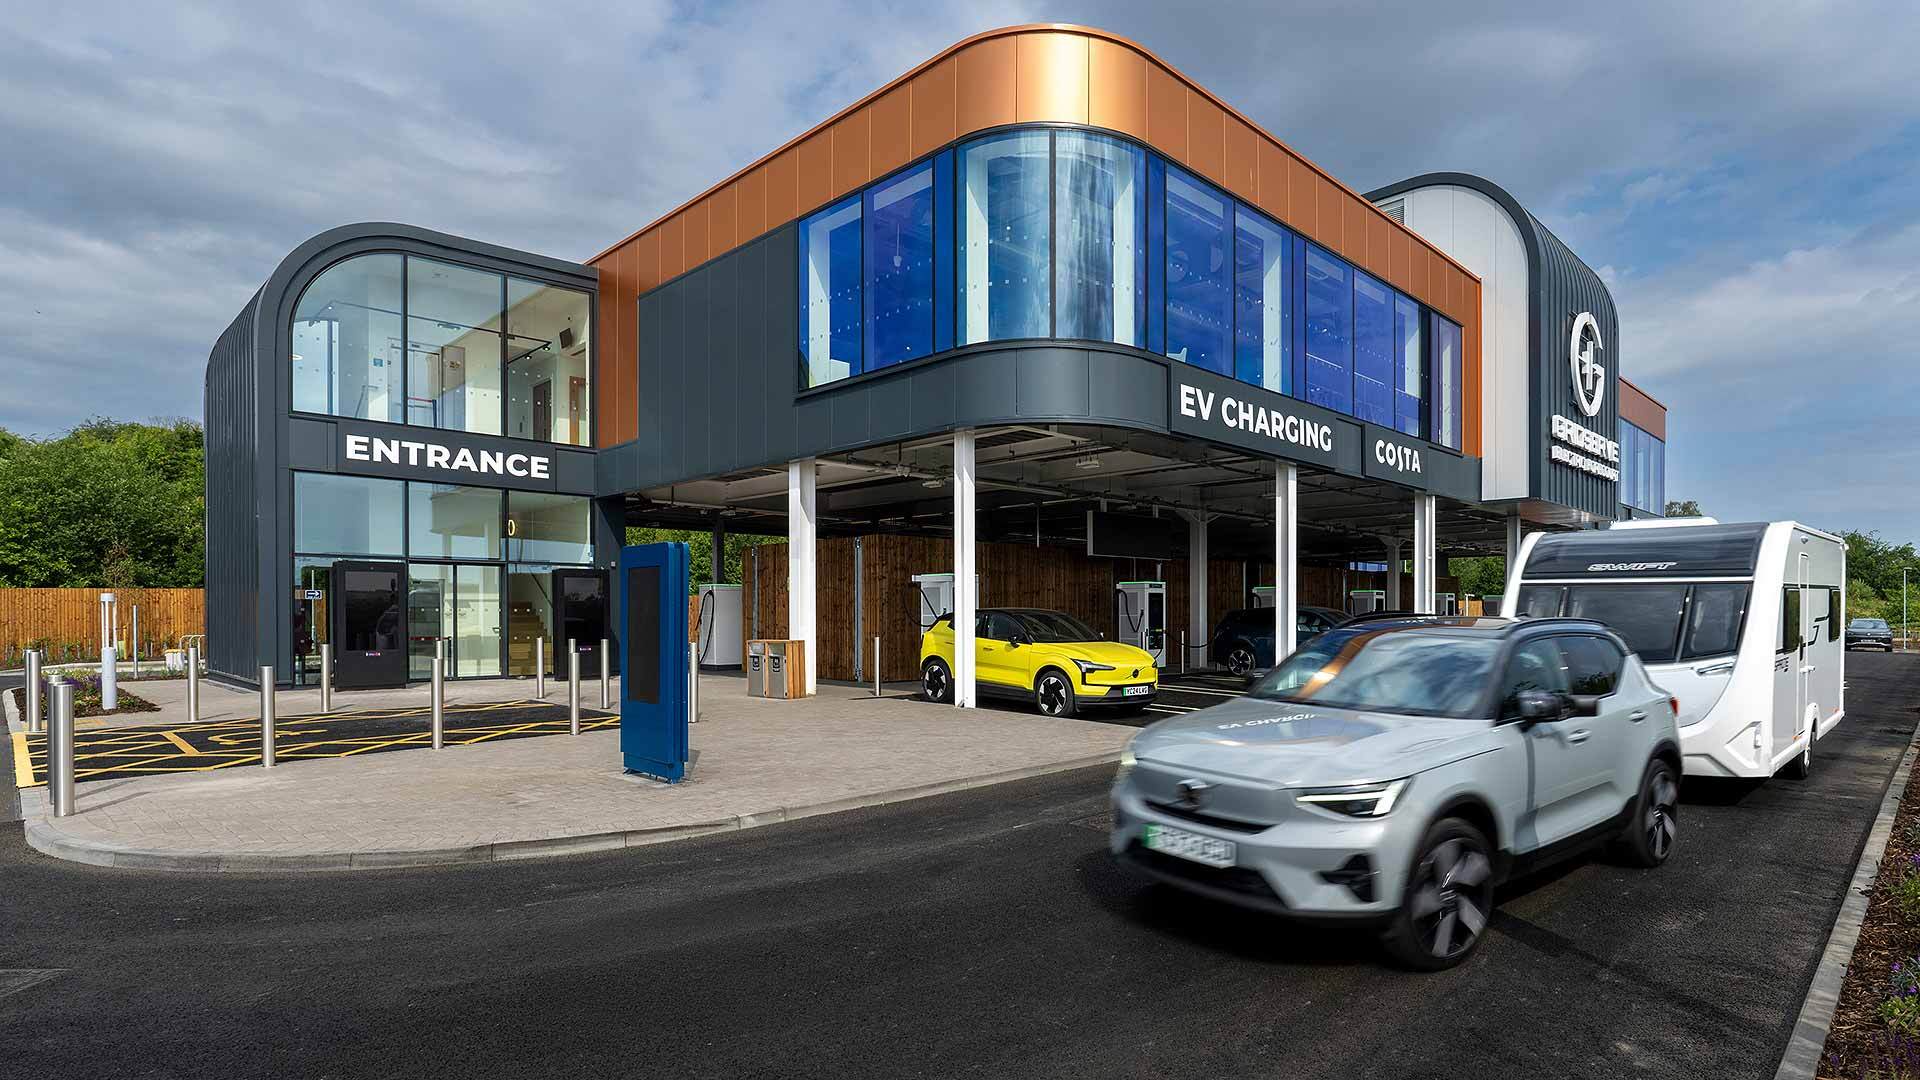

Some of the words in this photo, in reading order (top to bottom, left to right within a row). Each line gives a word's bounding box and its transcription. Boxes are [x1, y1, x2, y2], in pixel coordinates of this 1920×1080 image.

[1180, 384, 1214, 421] EV
[1221, 397, 1332, 452] CHARGING
[346, 434, 550, 479] ENTRANCE
[1375, 439, 1422, 473] COSTA
[1587, 561, 1678, 572] SWIFT
